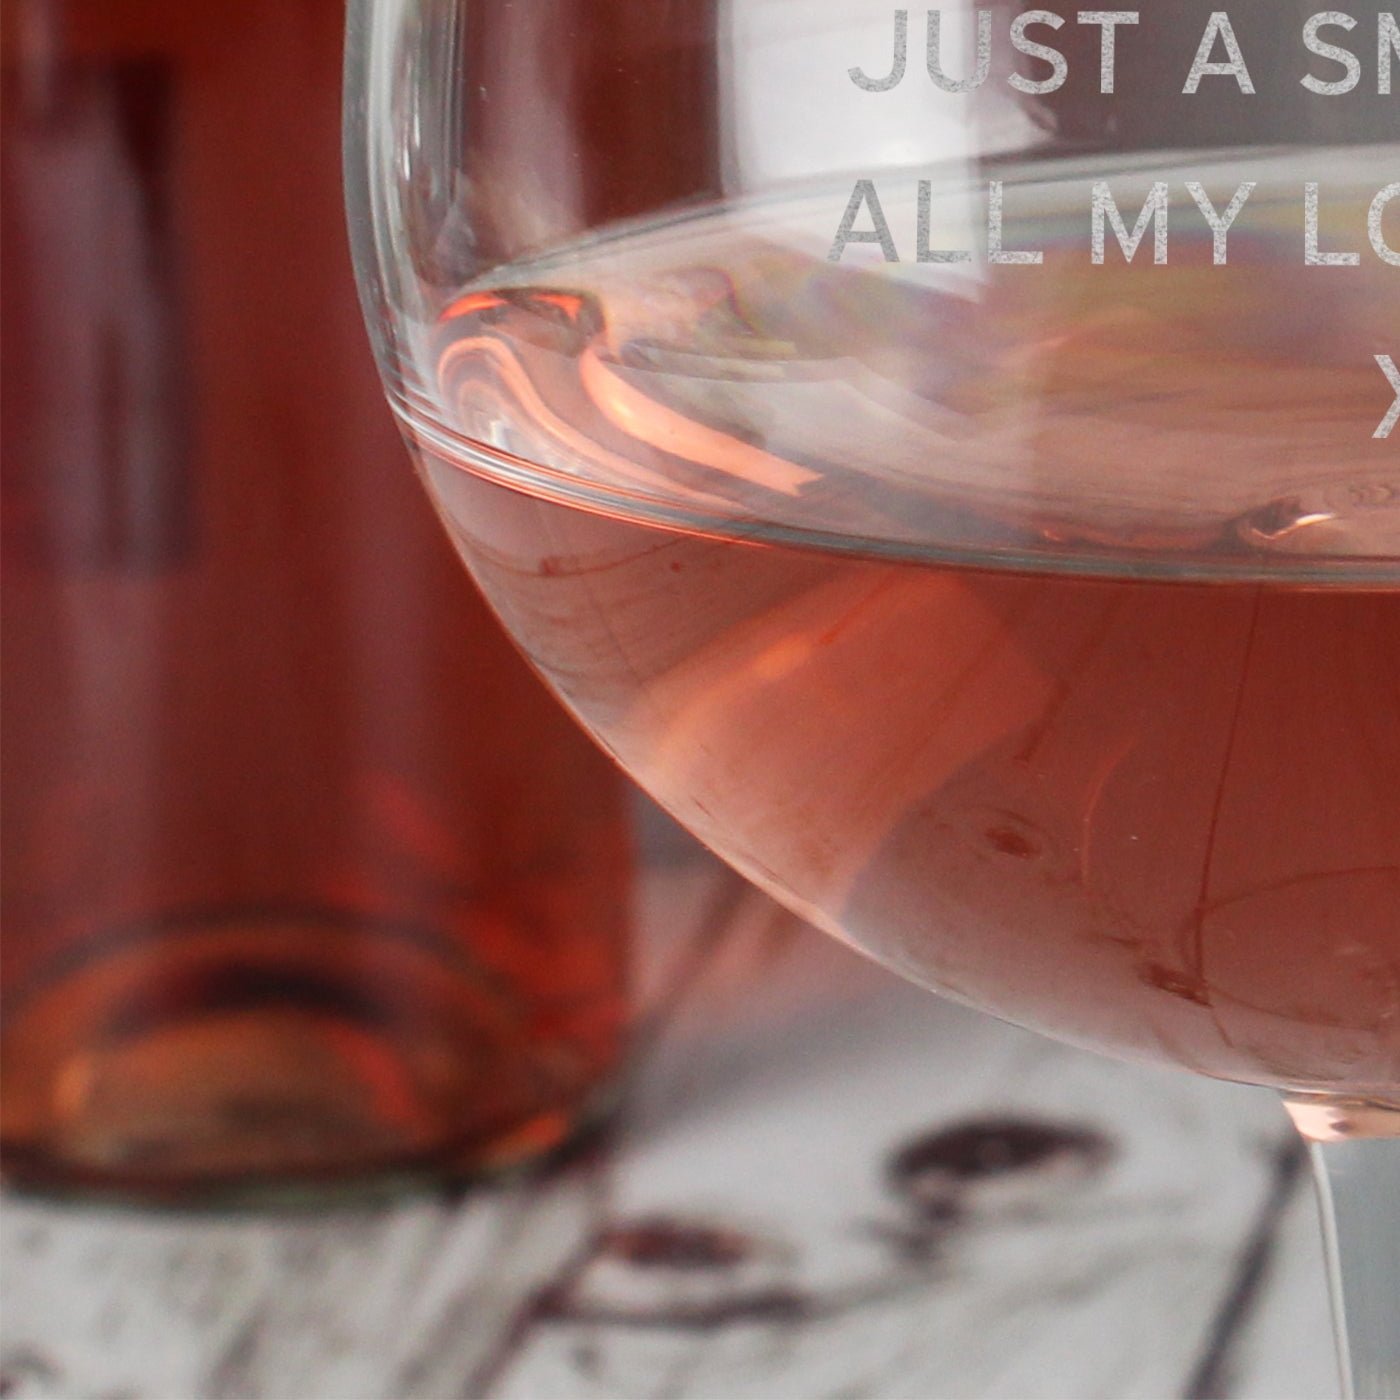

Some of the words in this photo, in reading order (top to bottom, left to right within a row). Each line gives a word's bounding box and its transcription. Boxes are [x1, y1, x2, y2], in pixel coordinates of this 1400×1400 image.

[846, 9, 1140, 95] JUST
[1180, 11, 1256, 94] A
[826, 179, 1044, 266] ALL
[1089, 181, 1258, 266] MY
